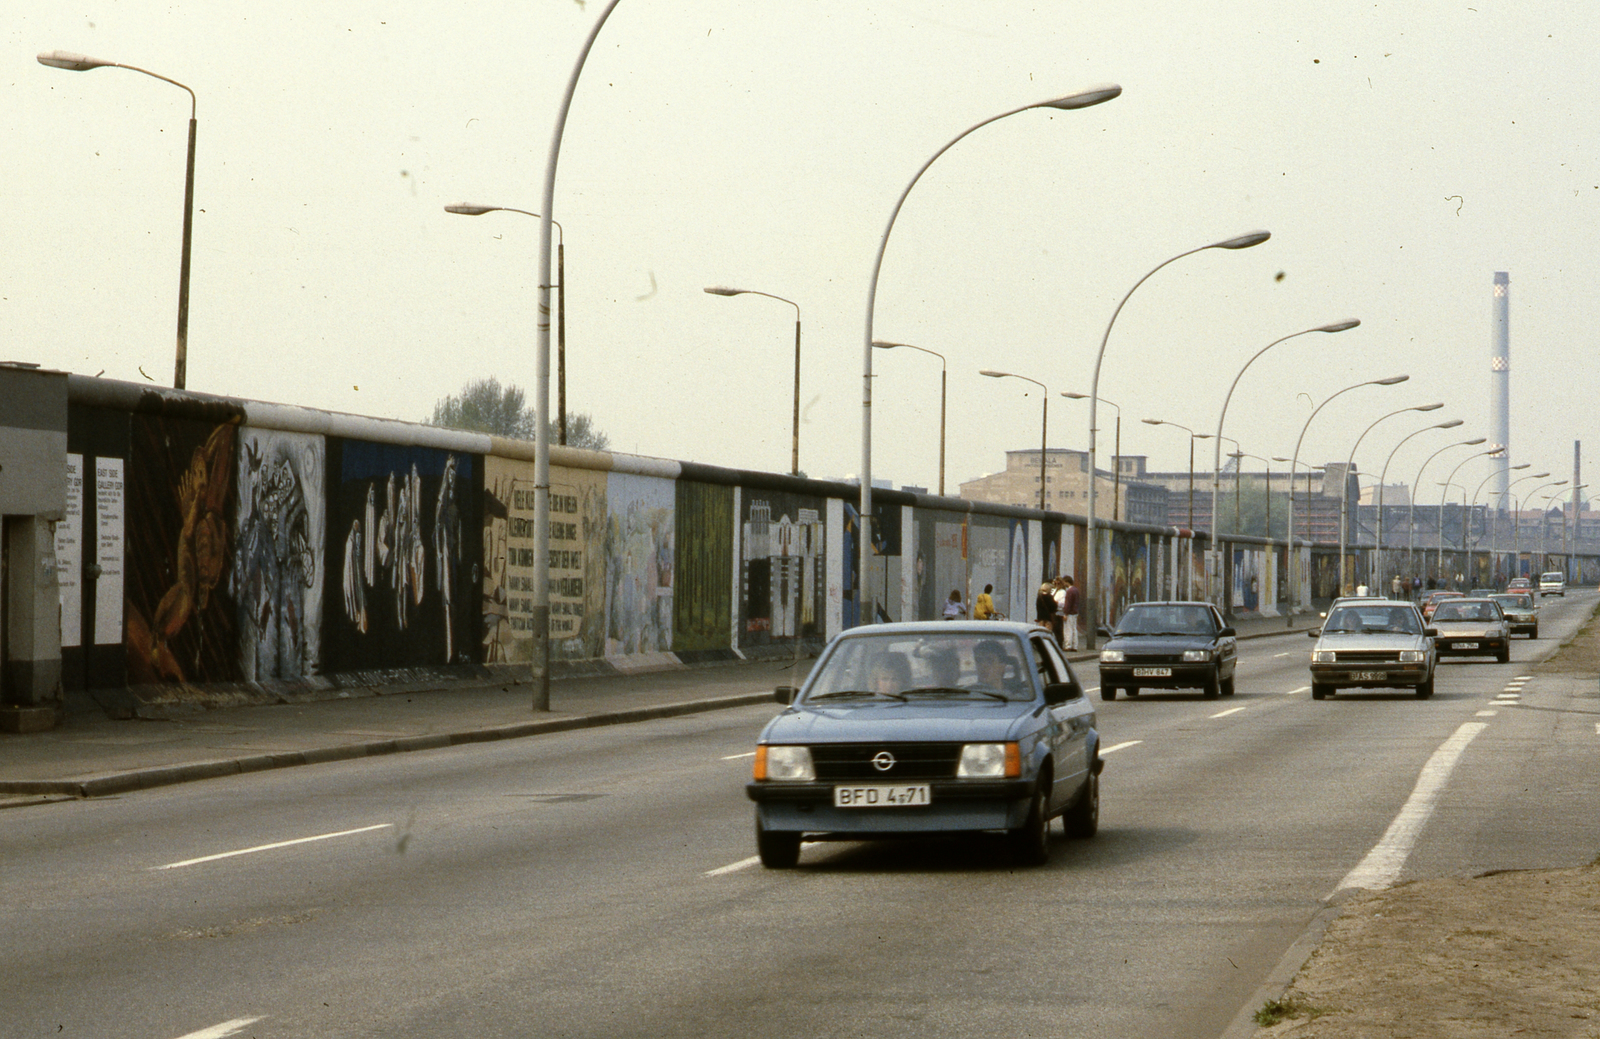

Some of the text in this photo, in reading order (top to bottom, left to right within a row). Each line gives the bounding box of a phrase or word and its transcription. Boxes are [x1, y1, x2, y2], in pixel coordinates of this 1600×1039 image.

[98, 468, 118, 478] EAST SIDE
[98, 480, 114, 490] GALLERY
[840, 788, 879, 804] BFD
